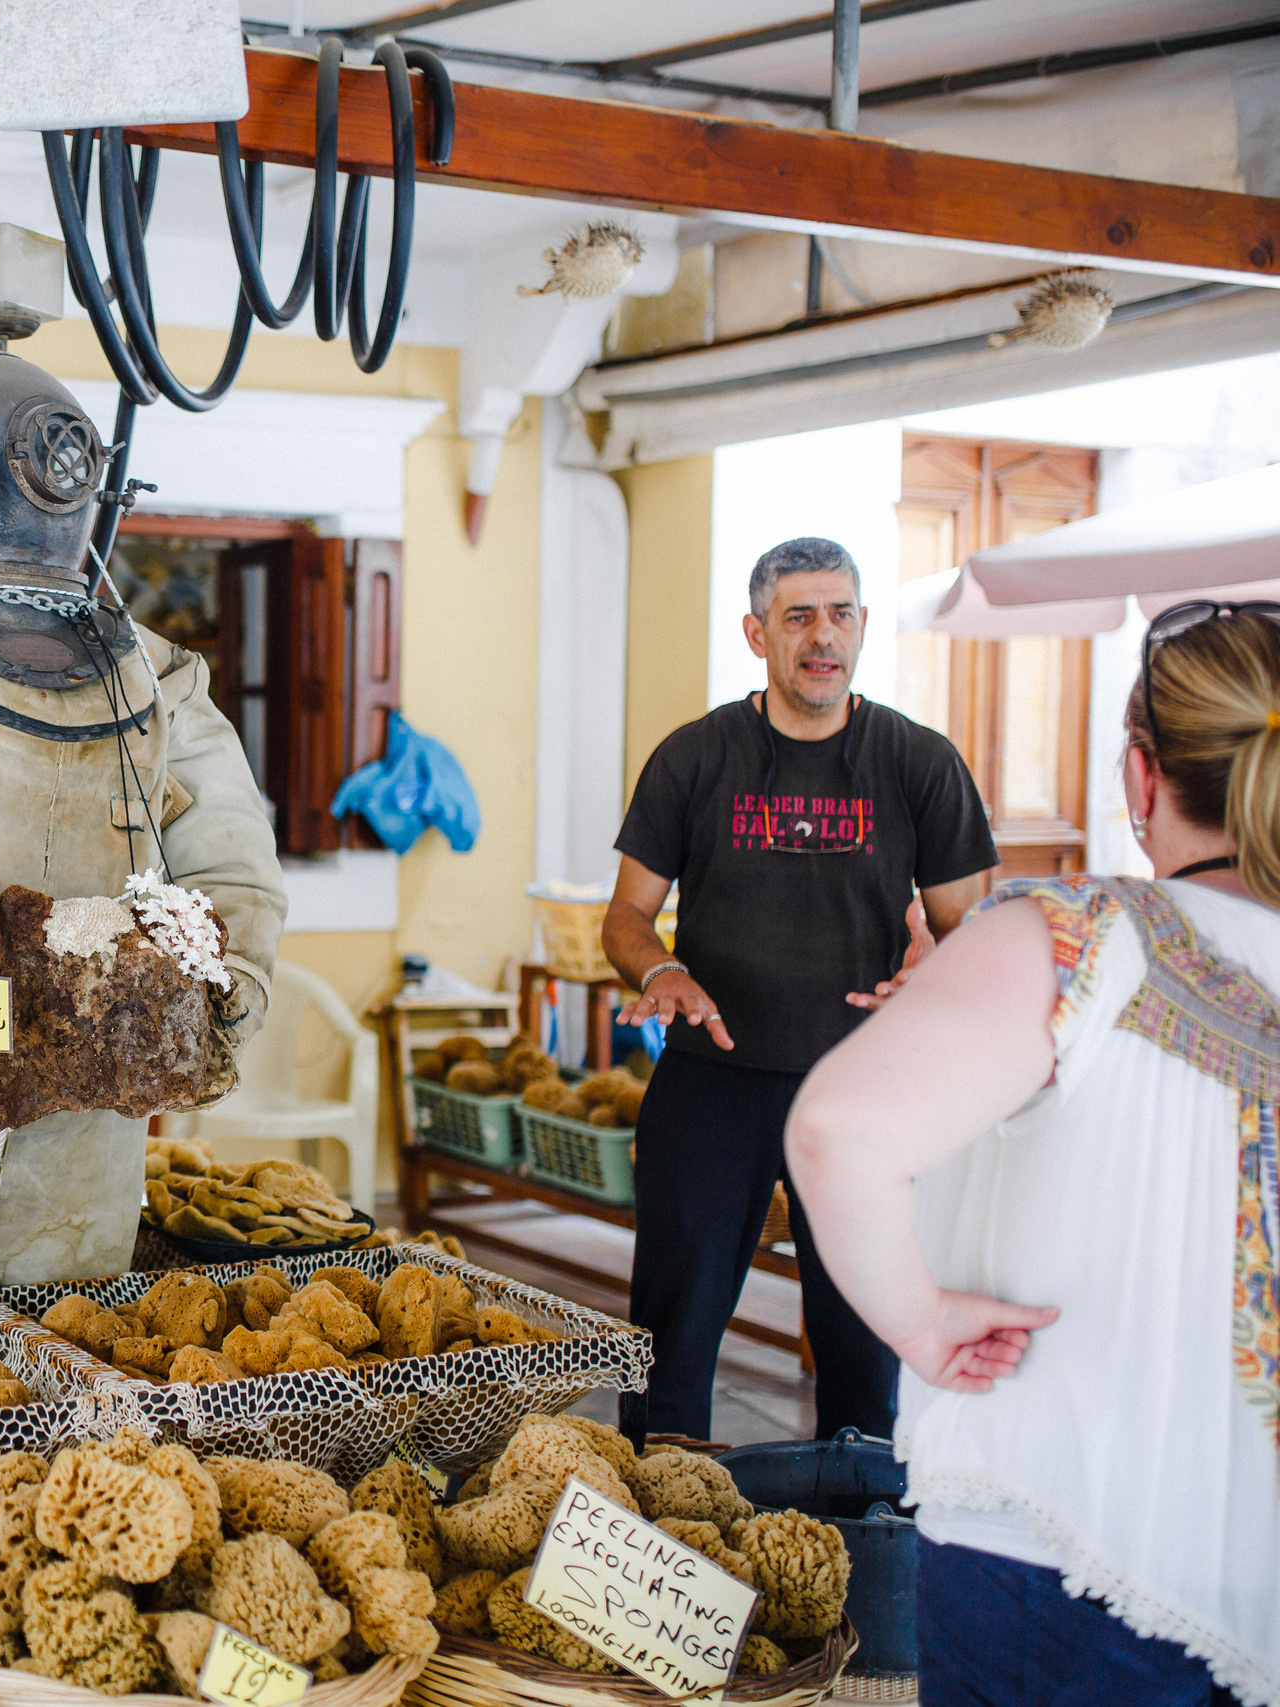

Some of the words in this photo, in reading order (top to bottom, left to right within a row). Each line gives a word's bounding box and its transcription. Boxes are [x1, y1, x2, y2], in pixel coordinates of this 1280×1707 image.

[734, 795, 805, 815] LEADER
[812, 798, 873, 816] BRAND
[552, 1521, 734, 1636] EXFOLIATING
[566, 1491, 697, 1578] PEELING
[562, 1564, 735, 1671] SPONGES
